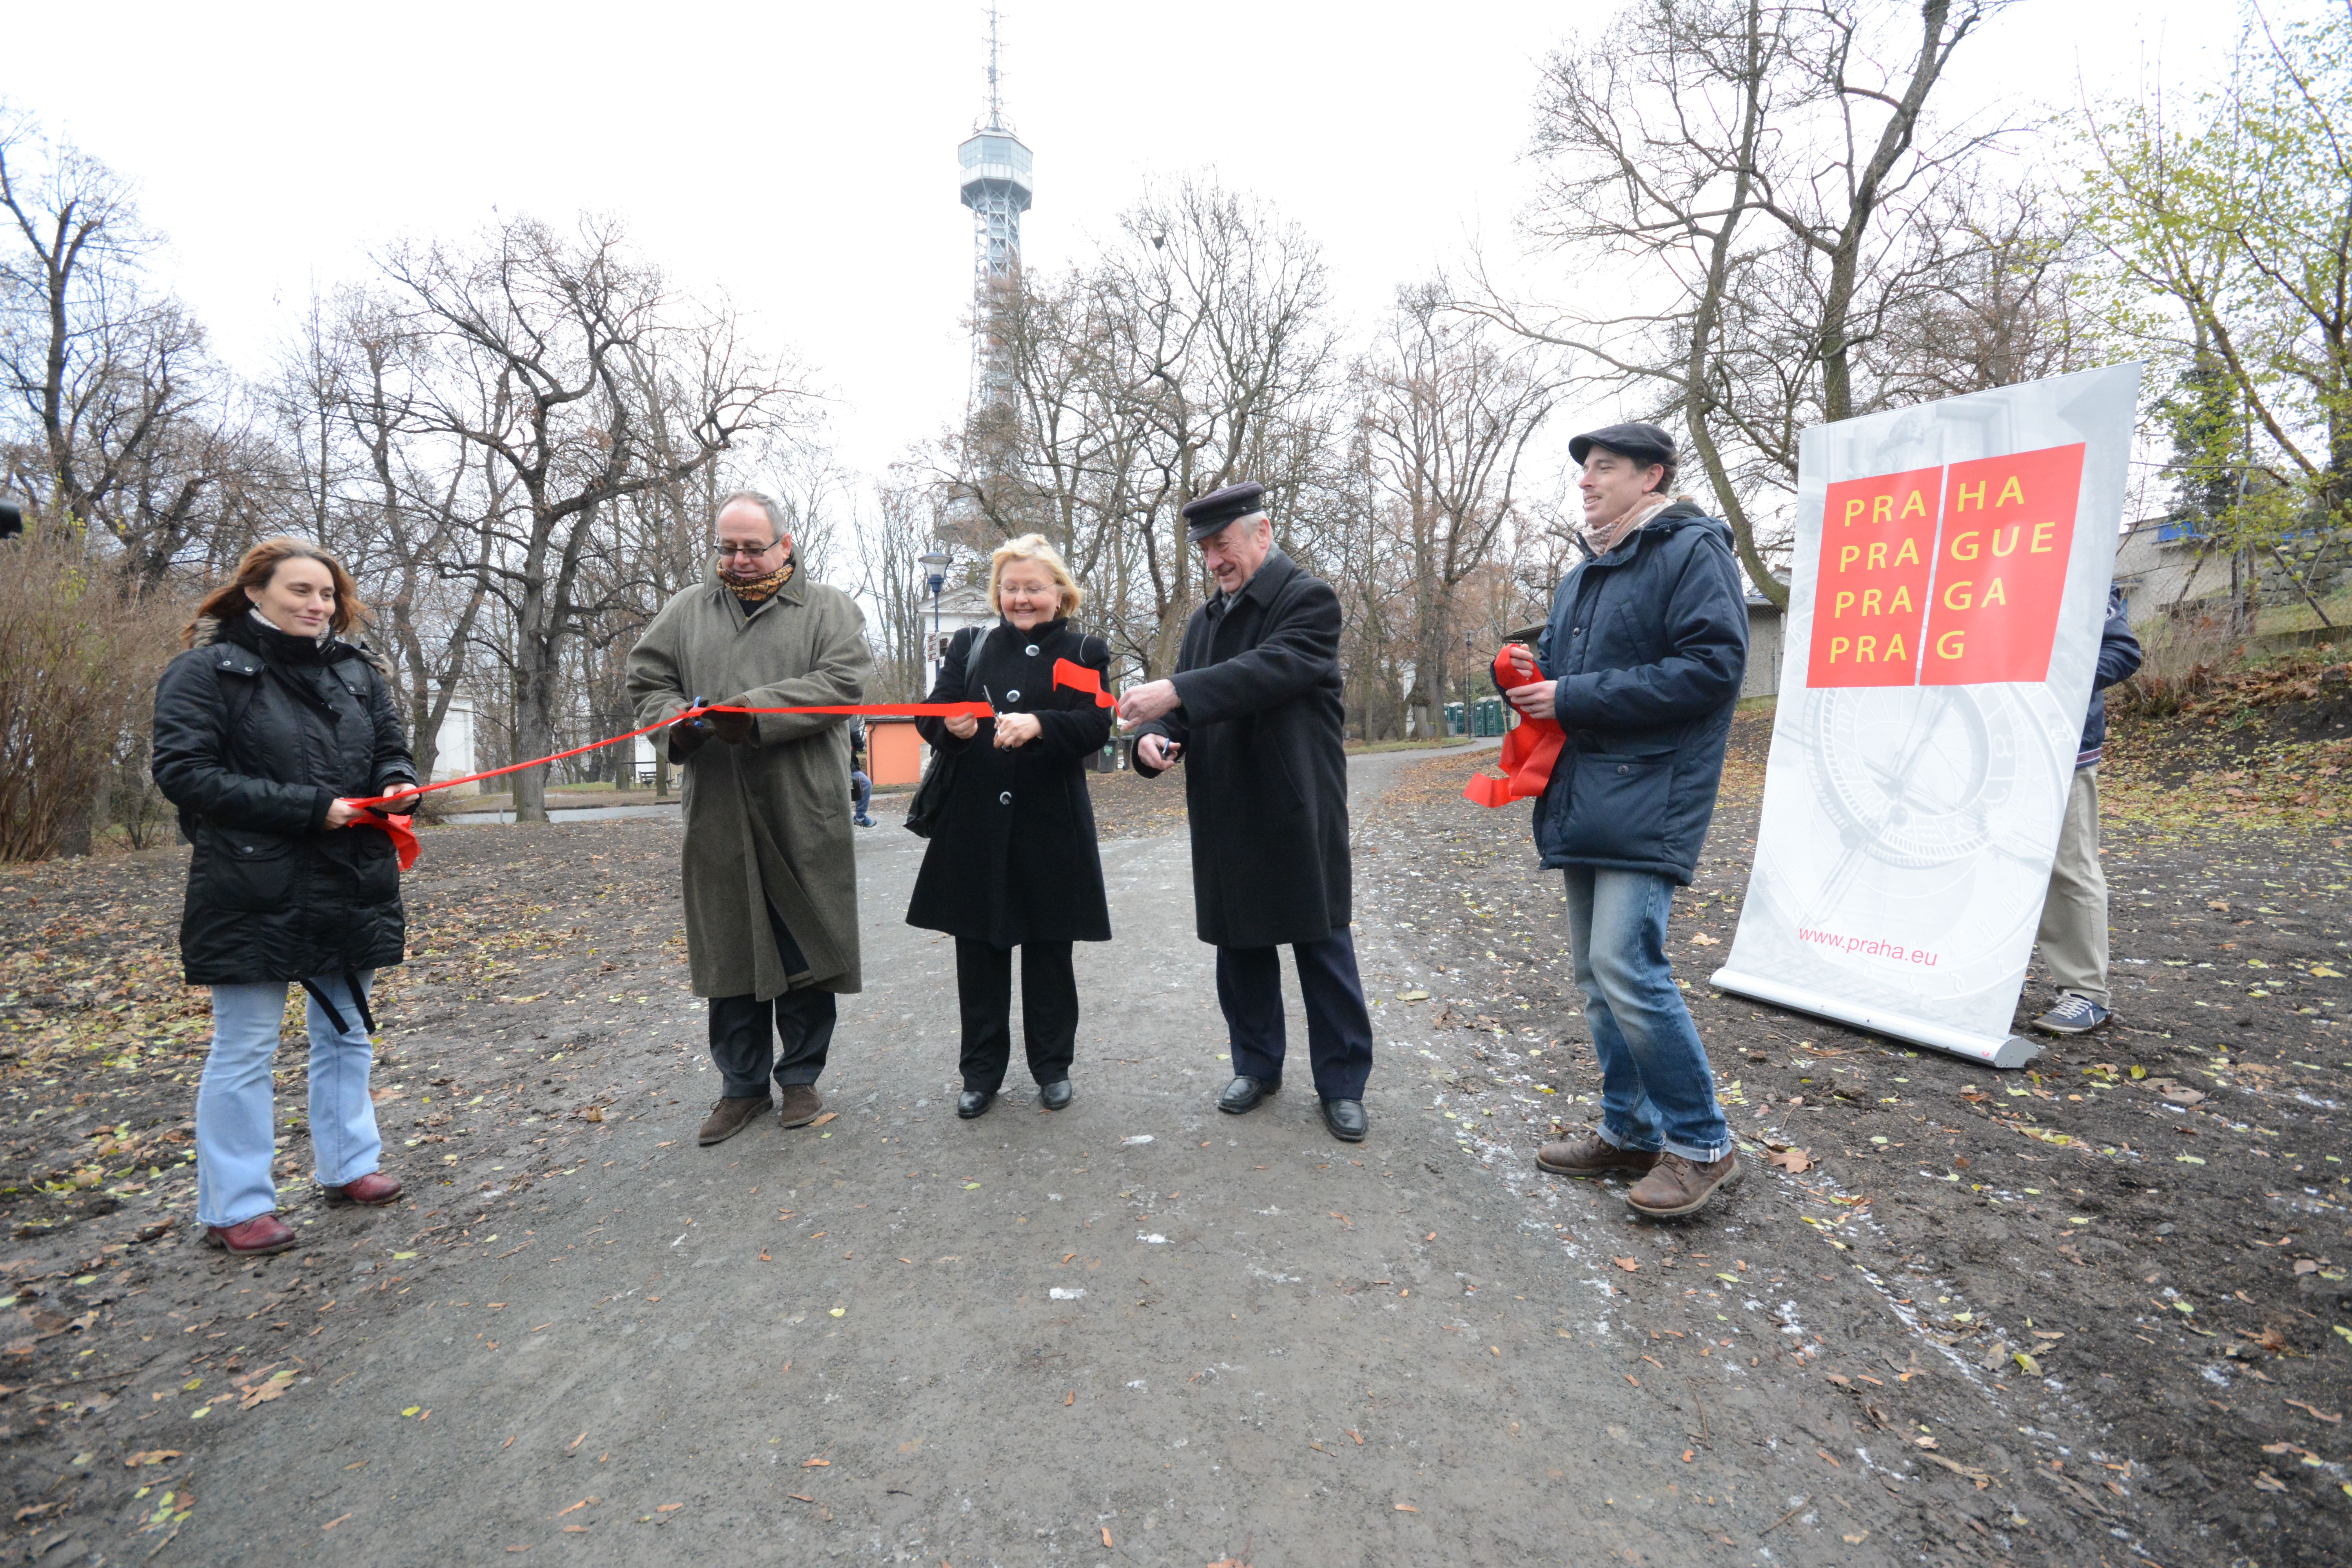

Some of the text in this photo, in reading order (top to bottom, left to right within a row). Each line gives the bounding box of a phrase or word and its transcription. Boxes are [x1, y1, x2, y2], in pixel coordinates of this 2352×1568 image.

[1844, 475, 2025, 528] PRA HA
[1839, 521, 2056, 573] PRA GUE
[1834, 577, 2007, 619] PRA GA
[1829, 633, 1907, 664] PRA
[1799, 928, 1938, 966] www.praha.eu
